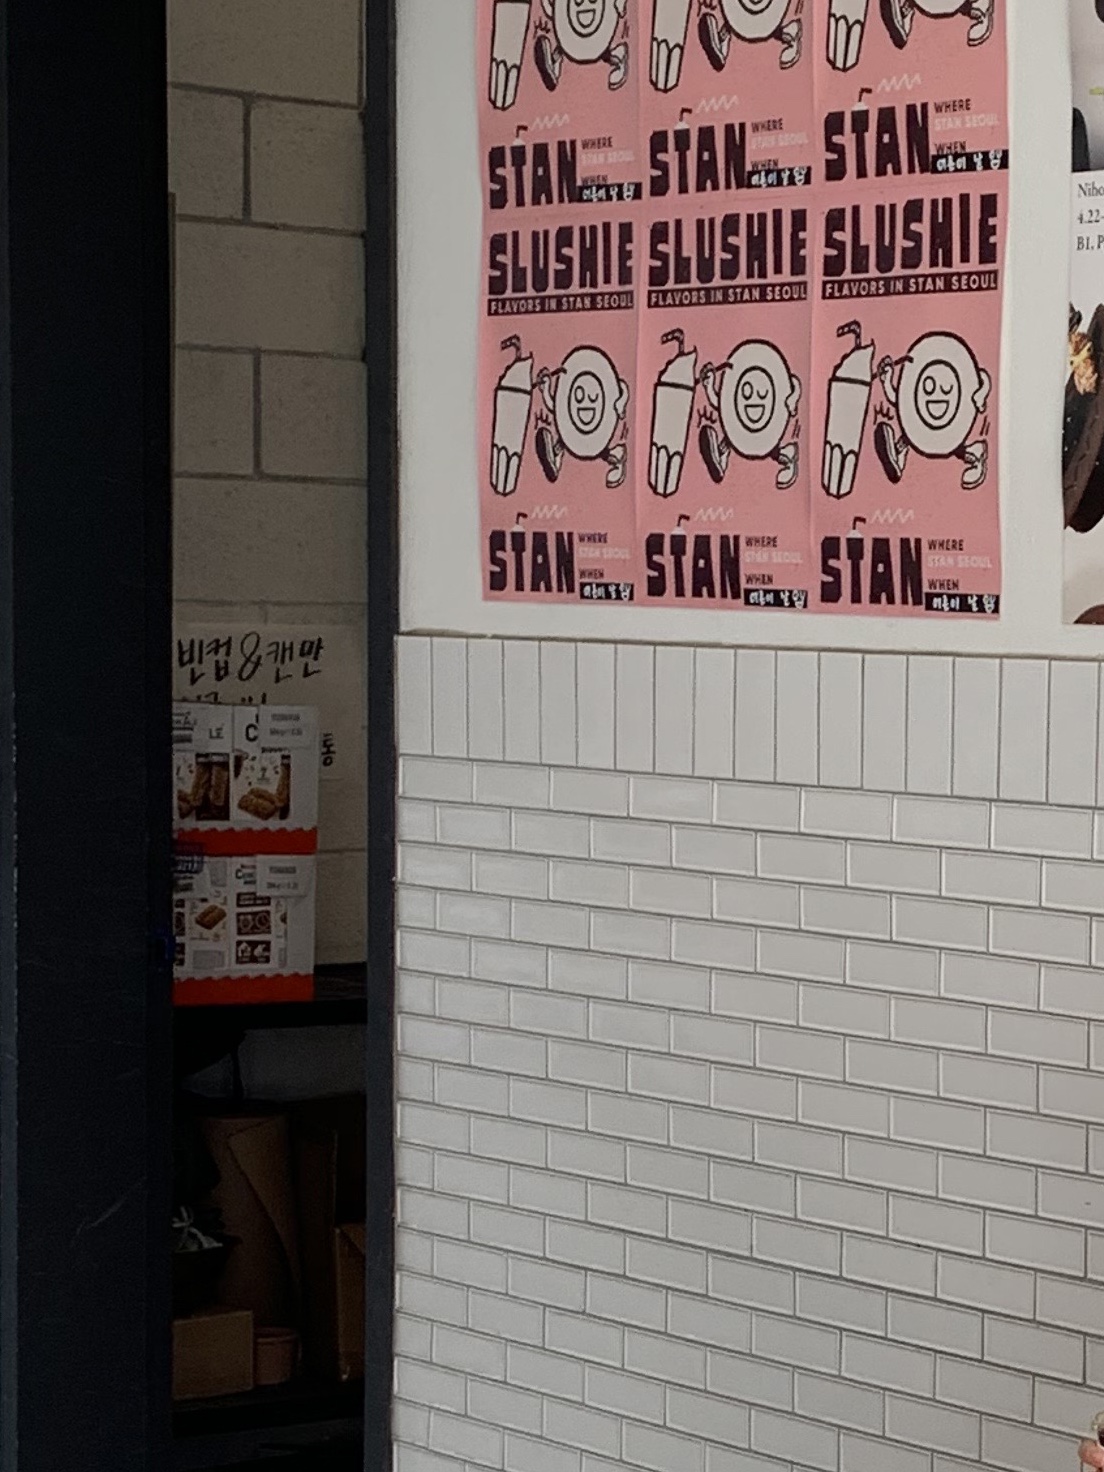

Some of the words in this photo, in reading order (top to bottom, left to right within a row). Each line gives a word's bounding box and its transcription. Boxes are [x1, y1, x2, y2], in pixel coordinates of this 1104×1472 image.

[934, 98, 971, 114] WHERE
[752, 118, 783, 133] WHERE
[580, 136, 613, 150] WHERE
[824, 102, 930, 181] STAN
[935, 141, 967, 155] WHEN
[650, 122, 746, 197] STAN
[488, 139, 576, 210] STAN
[823, 193, 998, 277] SLUSHIE
[488, 222, 634, 296] SLUSHIE
[648, 212, 808, 288] SLUSHIE
[651, 290, 706, 306] FLAVORS
[711, 288, 723, 302] IN
[728, 287, 760, 301] STAN
[766, 285, 806, 300] SEOUL
[826, 280, 884, 298] FLAVORS
[890, 279, 903, 293] IN
[909, 277, 944, 292] STAN
[952, 274, 996, 290] SEOUL
[490, 301, 541, 314] FLAVORS
[545, 299, 557, 311] IN
[562, 297, 591, 310] STAN
[596, 293, 634, 308] SEOUL
[745, 535, 778, 548] WHERE
[927, 538, 965, 551] WHERE
[489, 529, 575, 594] STAN
[646, 532, 741, 599] STAN
[820, 535, 923, 606] STAN
[745, 574, 774, 586] WHEN
[927, 578, 960, 591] WHEN
